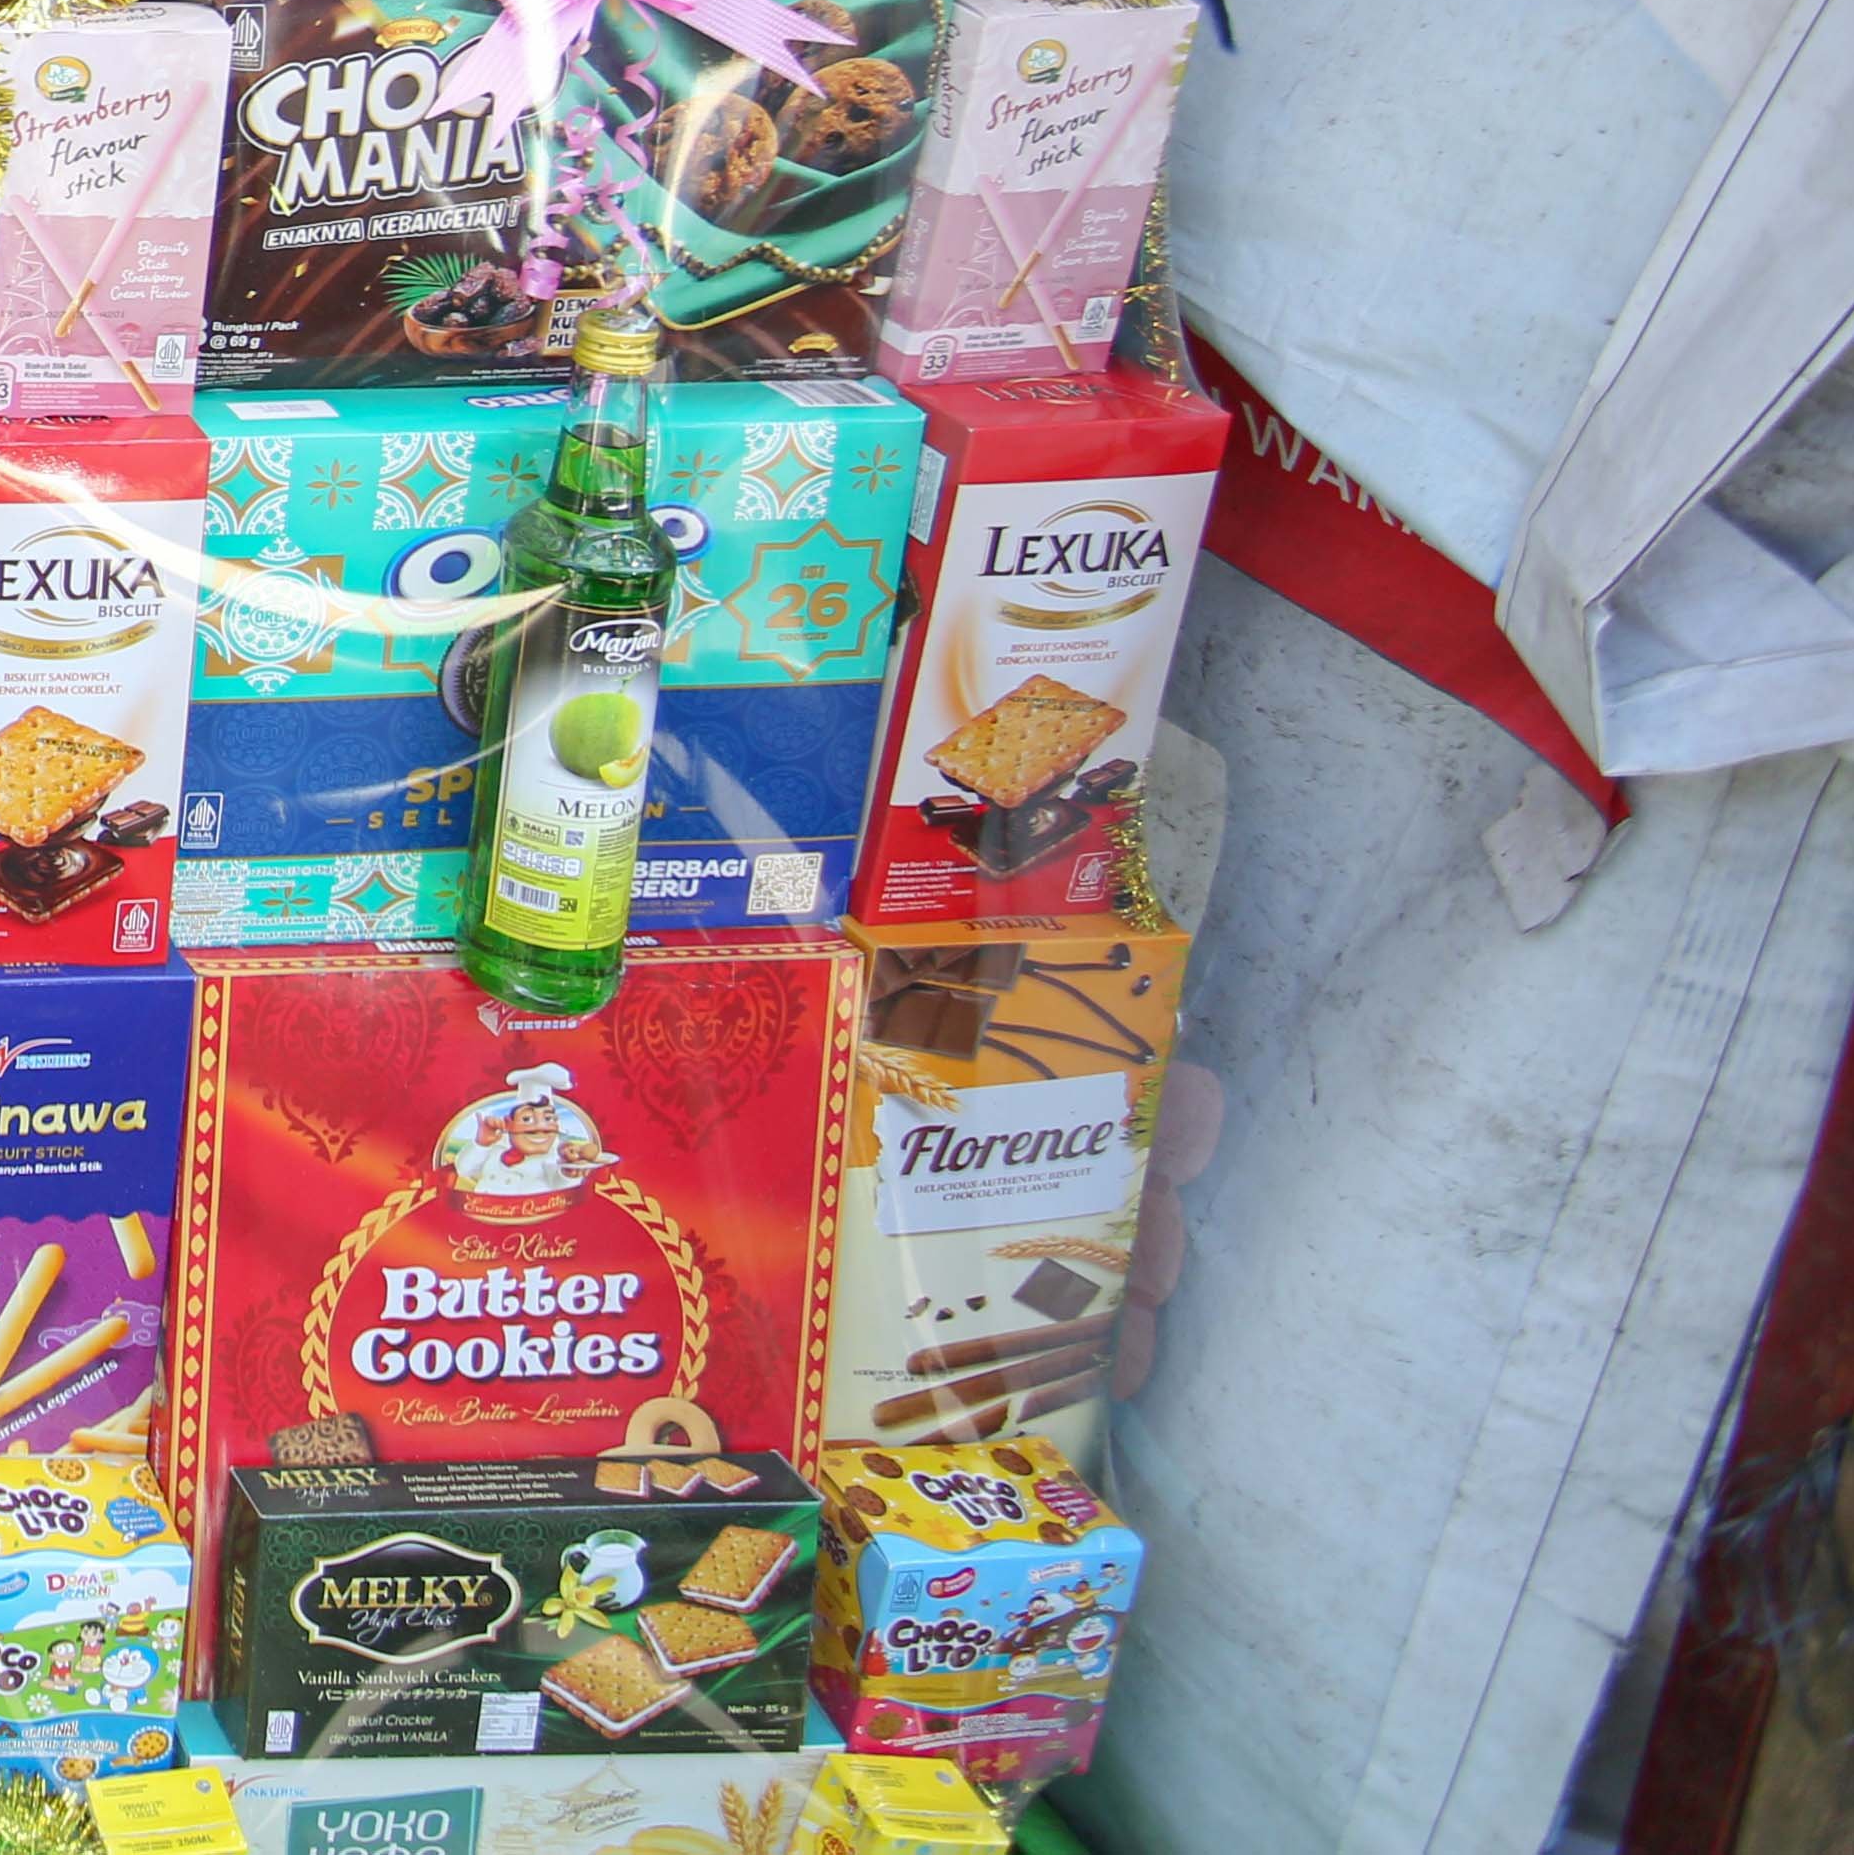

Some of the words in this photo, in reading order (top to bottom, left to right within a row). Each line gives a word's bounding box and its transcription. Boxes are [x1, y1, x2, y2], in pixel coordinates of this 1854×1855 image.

[245, 38, 565, 146] CHO
[986, 61, 1134, 132] Strawberry
[11, 83, 173, 148] Strawberry
[48, 132, 149, 178] flavour
[277, 117, 524, 207] MANIA
[63, 163, 127, 201] stick
[266, 222, 363, 250] ENAKNYA
[369, 206, 505, 240] KEBANGETAN
[977, 523, 1173, 579] LEXUKA
[97, 602, 163, 619] BISCUIT
[765, 582, 851, 628] 26
[569, 617, 663, 664] Marjan
[34, 1145, 85, 1159] STICK
[899, 1118, 1116, 1178] Florence
[504, 1232, 579, 1261] Klasik
[380, 1265, 643, 1324] Butter
[350, 1320, 663, 1383] Cookies
[36, 1358, 120, 1420] Legendaris
[522, 1396, 625, 1427] Legendaris
[319, 1575, 492, 1609] MELKY
[887, 1618, 994, 1648] CHOCO
[297, 1668, 352, 1686] Vanilla
[355, 1668, 430, 1685] Sandwich
[434, 1668, 502, 1685] Crackers
[385, 1713, 435, 1726] Cracker
[317, 1808, 452, 1844] YOKO
